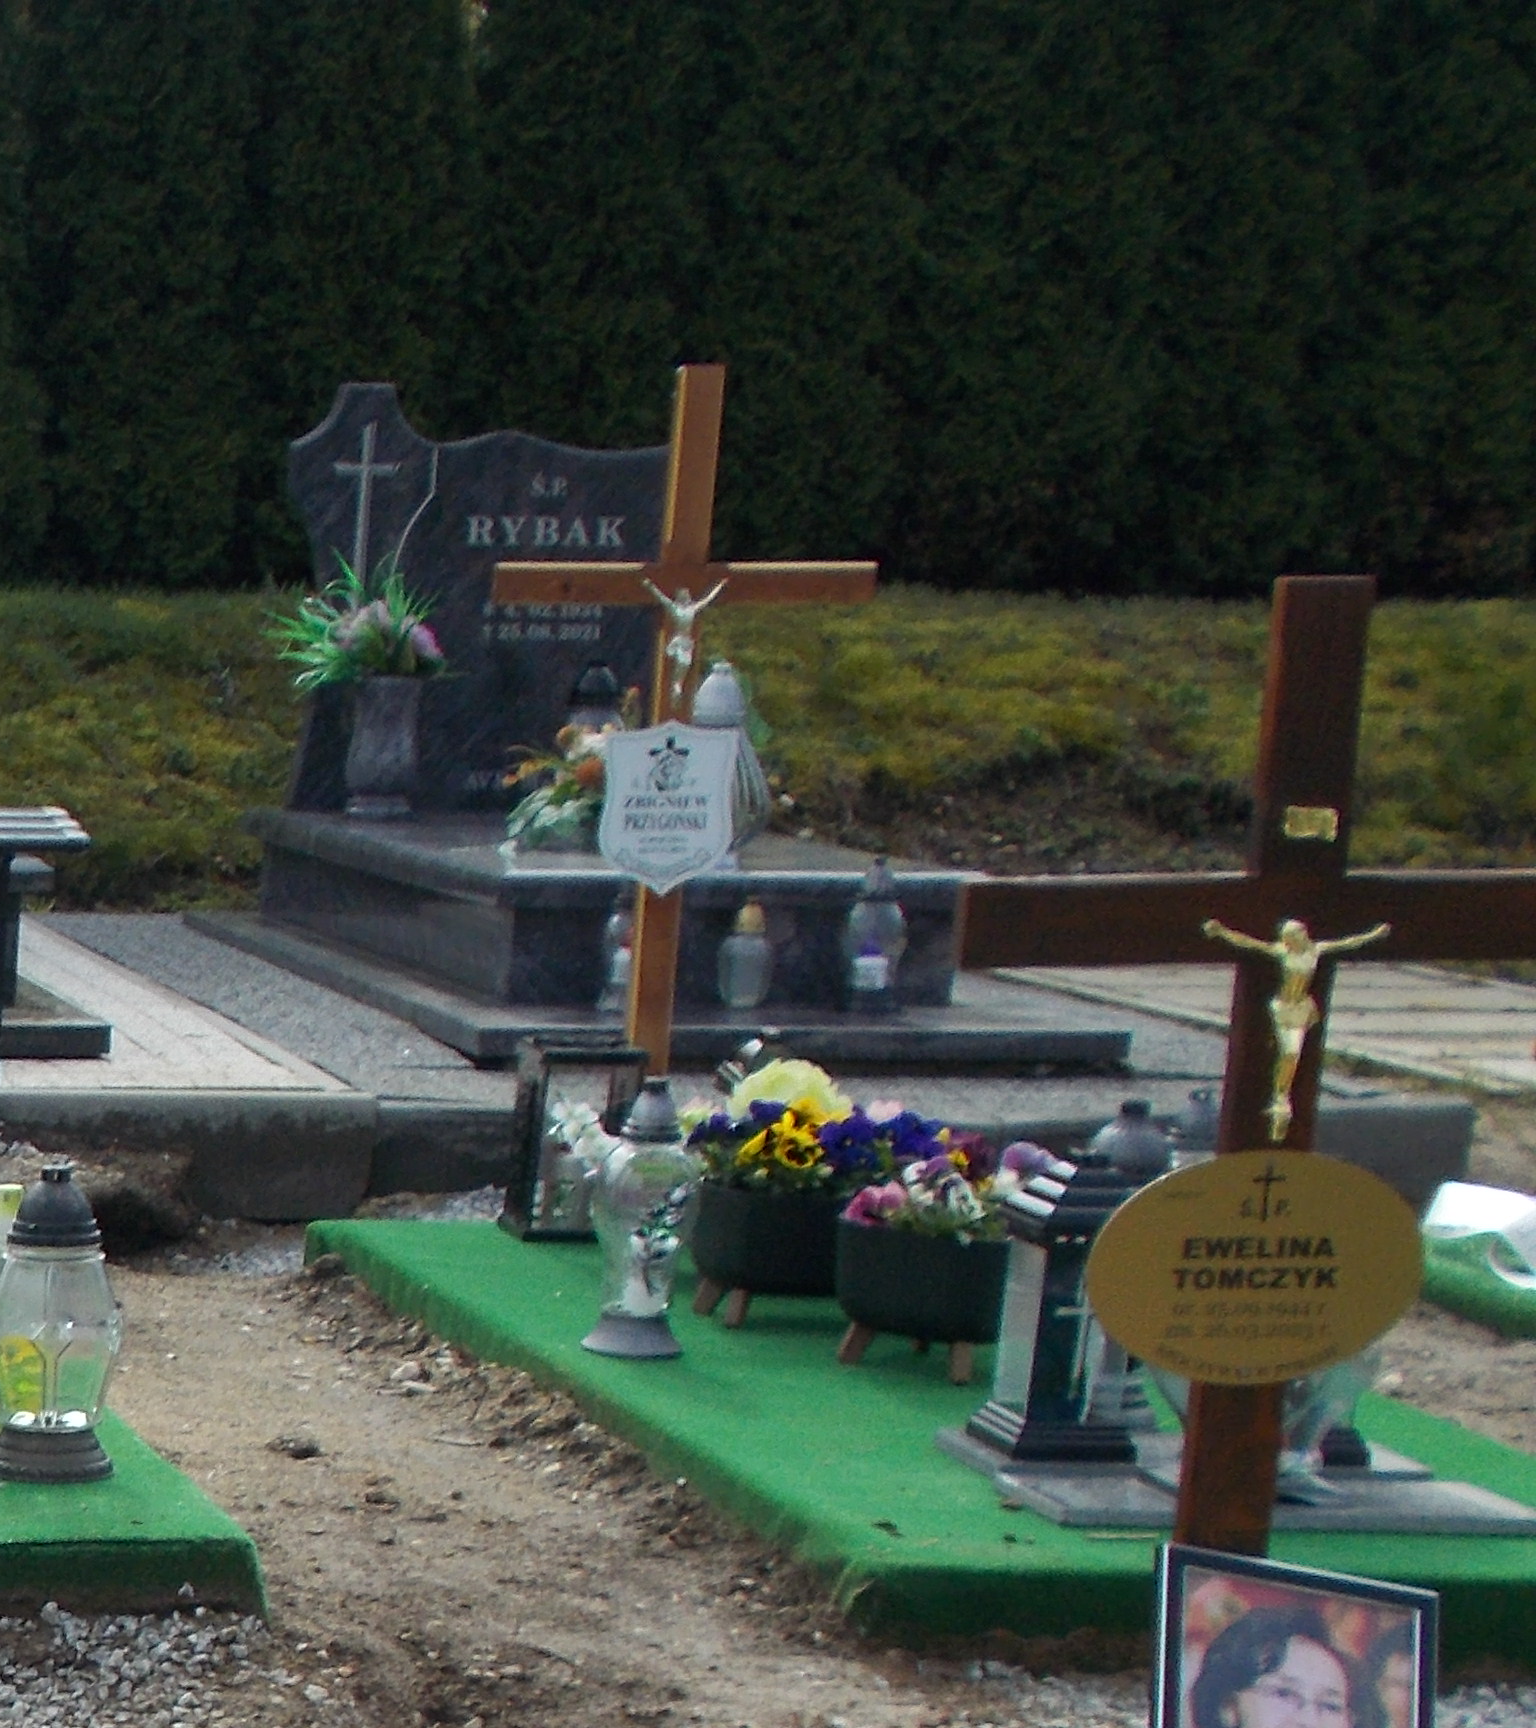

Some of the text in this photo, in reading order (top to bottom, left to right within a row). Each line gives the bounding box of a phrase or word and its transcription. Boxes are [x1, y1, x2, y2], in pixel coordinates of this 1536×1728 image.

[465, 514, 627, 548] RYBAK
[1181, 1235, 1335, 1261] EWELINA
[1172, 1265, 1339, 1292] TOMCZYK
